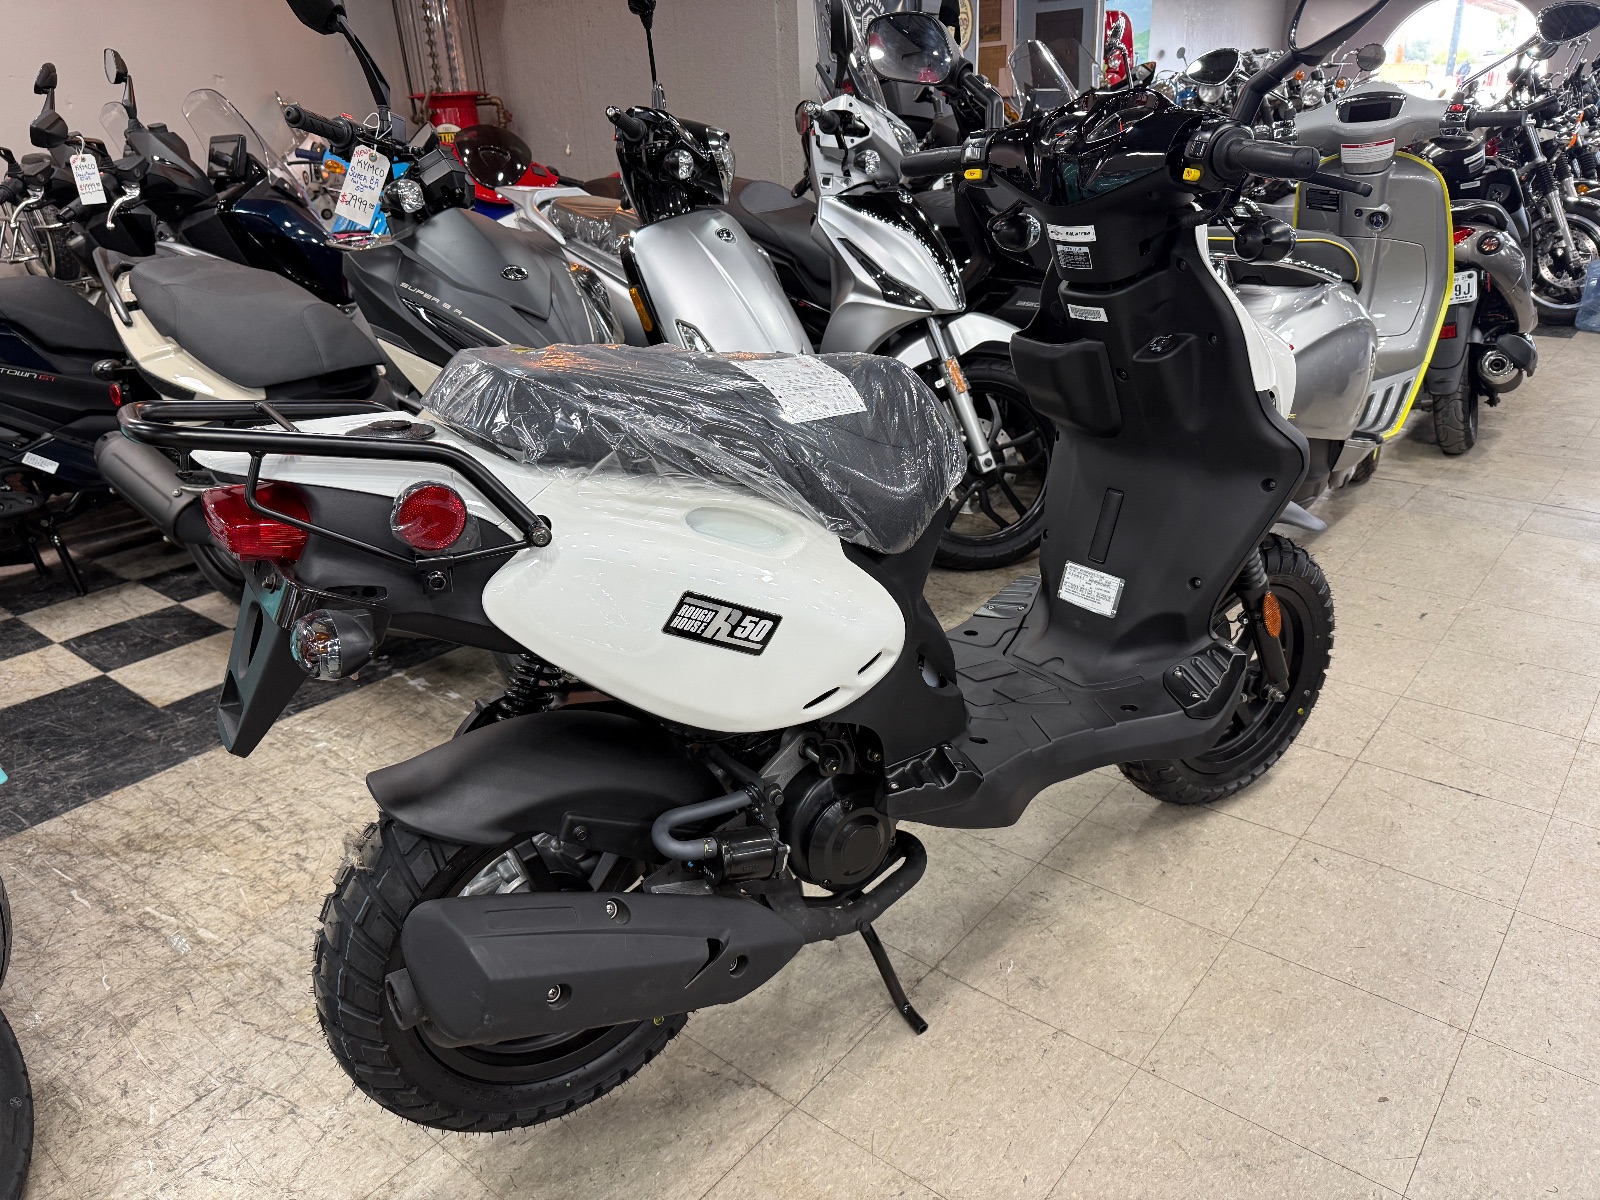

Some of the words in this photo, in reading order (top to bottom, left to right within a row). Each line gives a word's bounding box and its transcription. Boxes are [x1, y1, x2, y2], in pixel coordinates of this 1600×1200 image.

[356, 159, 385, 178] KYMCO
[399, 282, 441, 304] SUPER
[677, 604, 715, 622] ROUGH
[670, 615, 708, 634] HOUSE
[733, 615, 775, 642] 50
